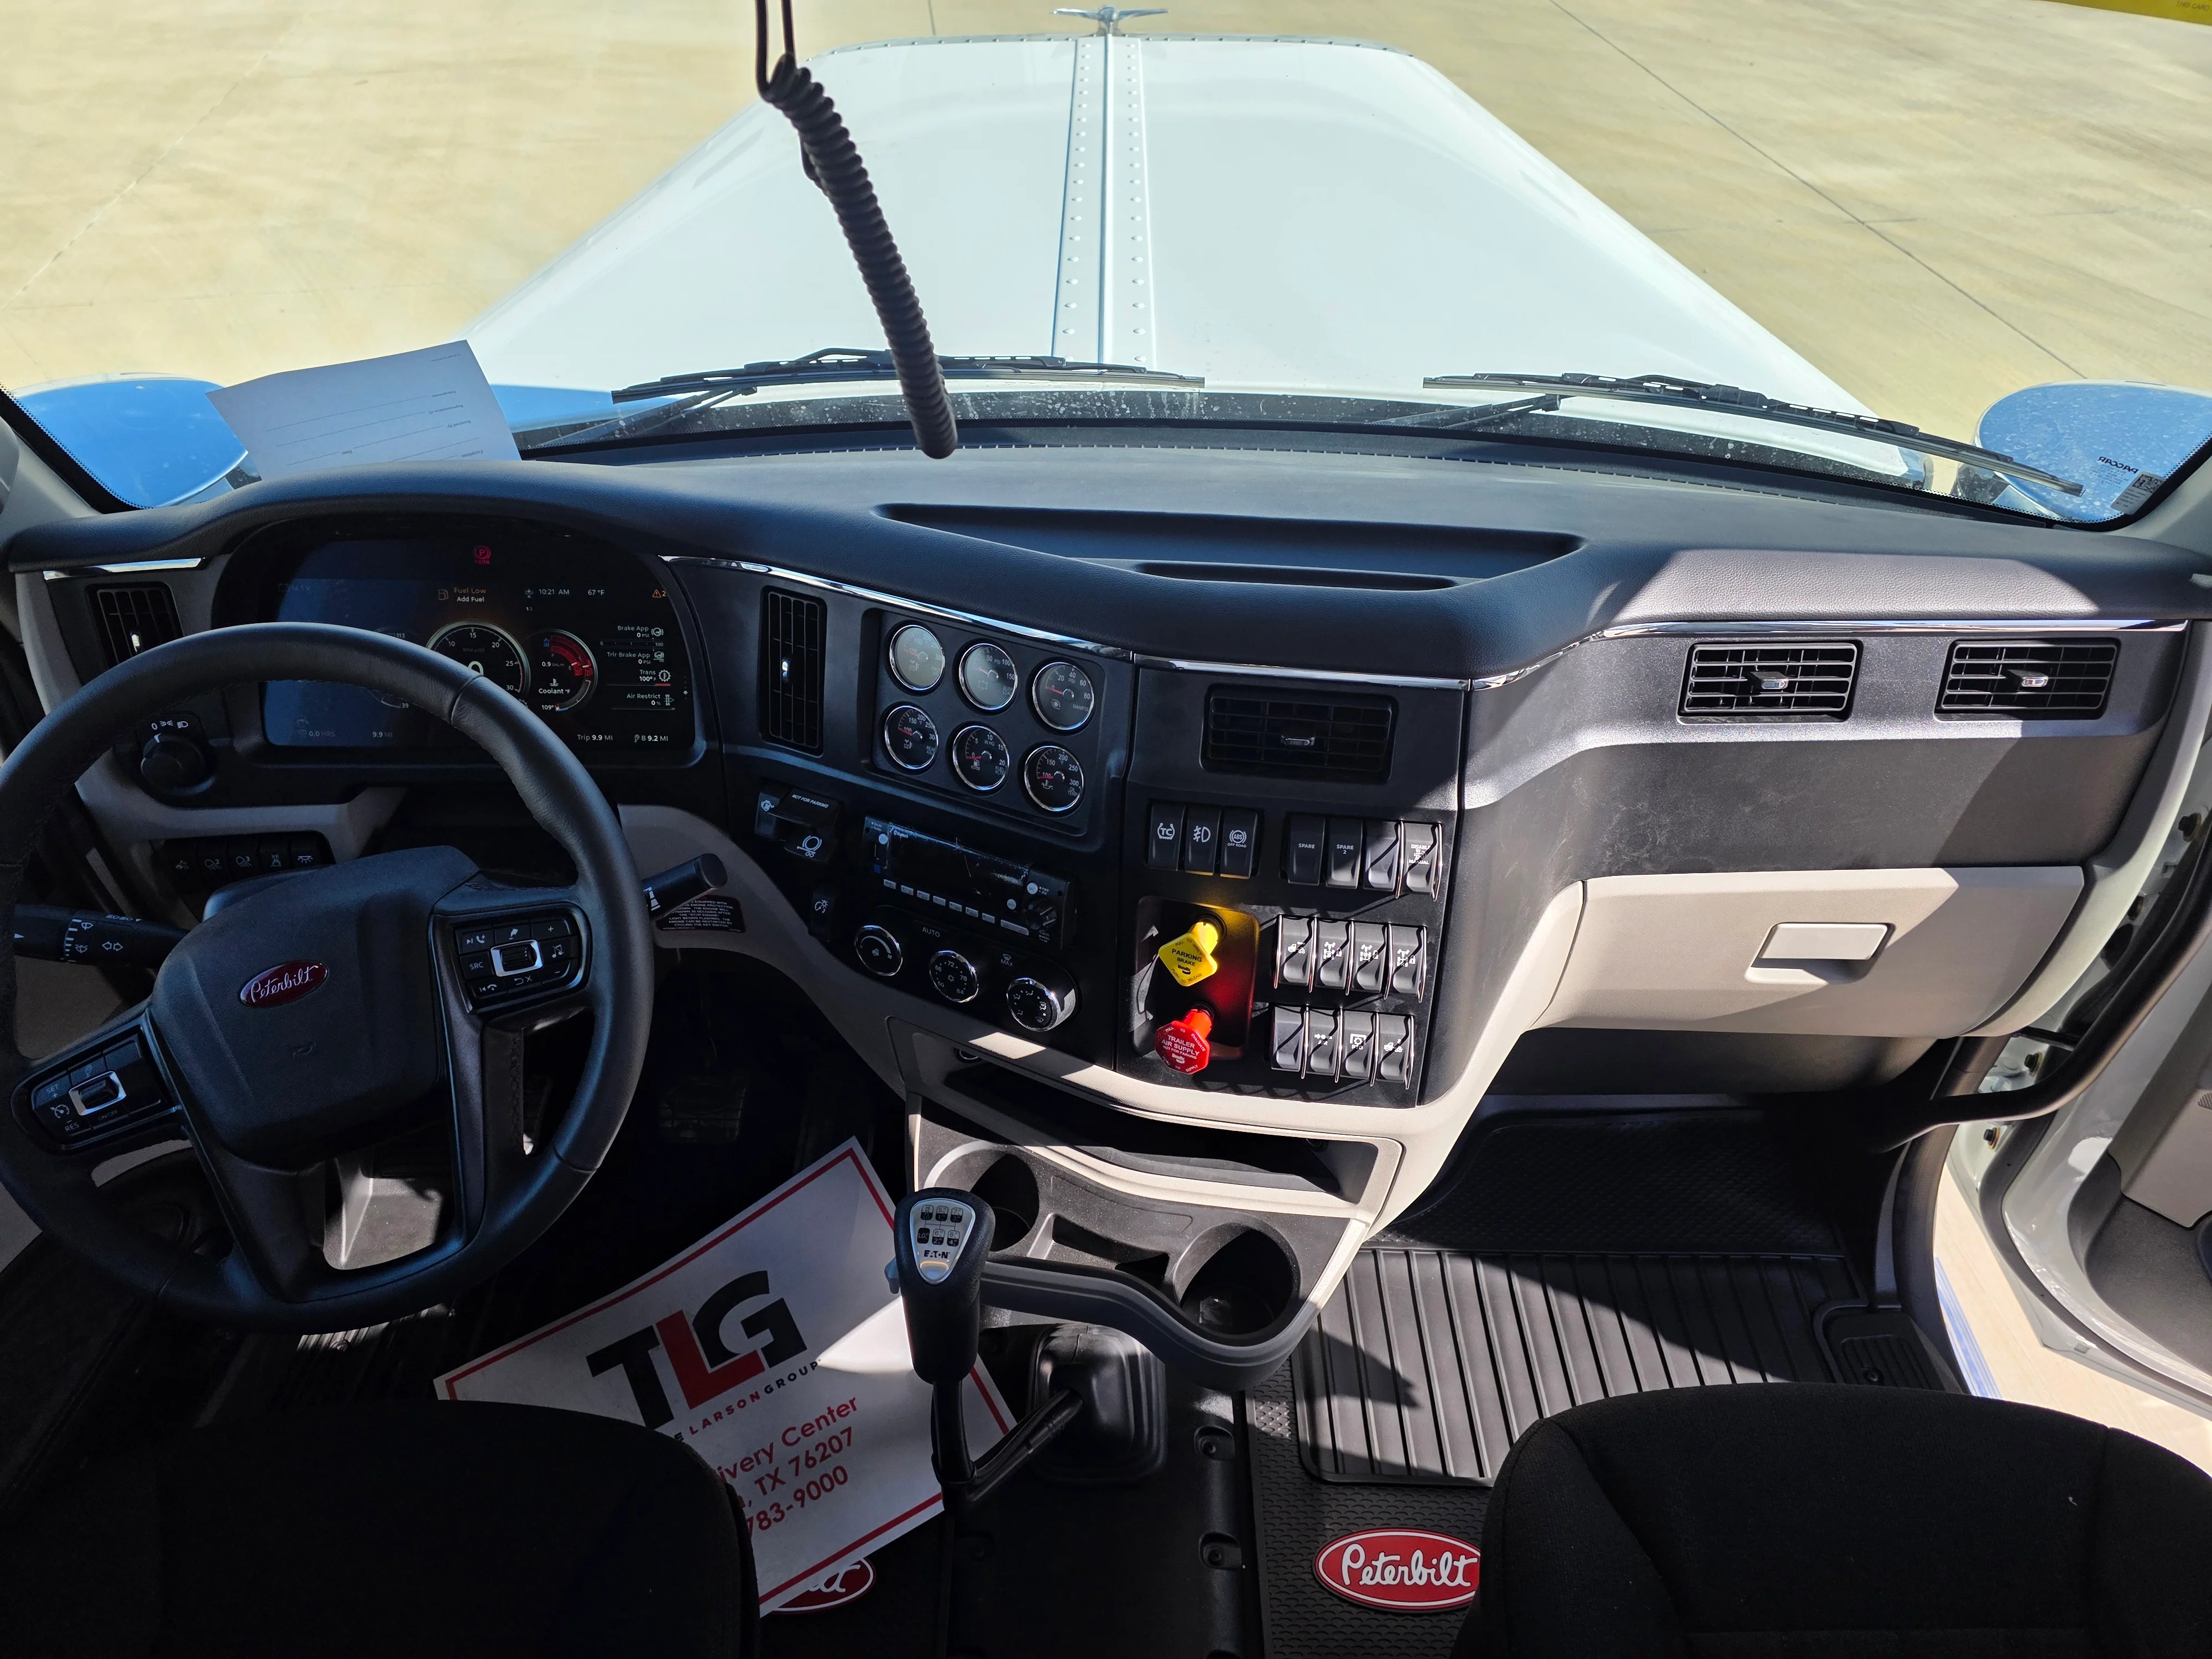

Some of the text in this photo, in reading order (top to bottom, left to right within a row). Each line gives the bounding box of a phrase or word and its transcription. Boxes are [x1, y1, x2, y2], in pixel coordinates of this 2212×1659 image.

[917, 713, 926, 722] 200
[577, 734, 591, 742] Trip
[1046, 758, 1056, 766] 150
[1058, 753, 1068, 762] 200
[1068, 764, 1079, 772] 250
[1069, 779, 1079, 787] 300
[809, 799, 830, 808] PARKING
[922, 926, 941, 938] AUTO
[1192, 943, 1203, 955] APPLY
[1171, 948, 1203, 963] PARKING
[469, 961, 484, 971] SRC
[947, 960, 955, 968] 72
[1000, 958, 1014, 967] MAX
[1176, 957, 1196, 967] BRAKE
[935, 964, 942, 972] 66
[959, 974, 968, 982] 78
[1187, 973, 1203, 982] RELEASE
[251, 965, 319, 1003] Peterbilt
[1167, 1035, 1196, 1049] TRAILER
[1191, 1033, 1206, 1052] EVACUATE
[1161, 1039, 1200, 1056] AIR SUPPLY
[1179, 1051, 1197, 1060] PARKING
[1185, 1064, 1199, 1072] SUPPLY
[46, 1083, 59, 1094] SET
[97, 1109, 118, 1121] ON/OFF
[65, 1121, 80, 1132] RES
[586, 1270, 807, 1431] TLG
[717, 1397, 858, 1483] ivery Center
[754, 1426, 853, 1496] TX 76207
[1341, 1543, 1478, 1587] Peterbilt
